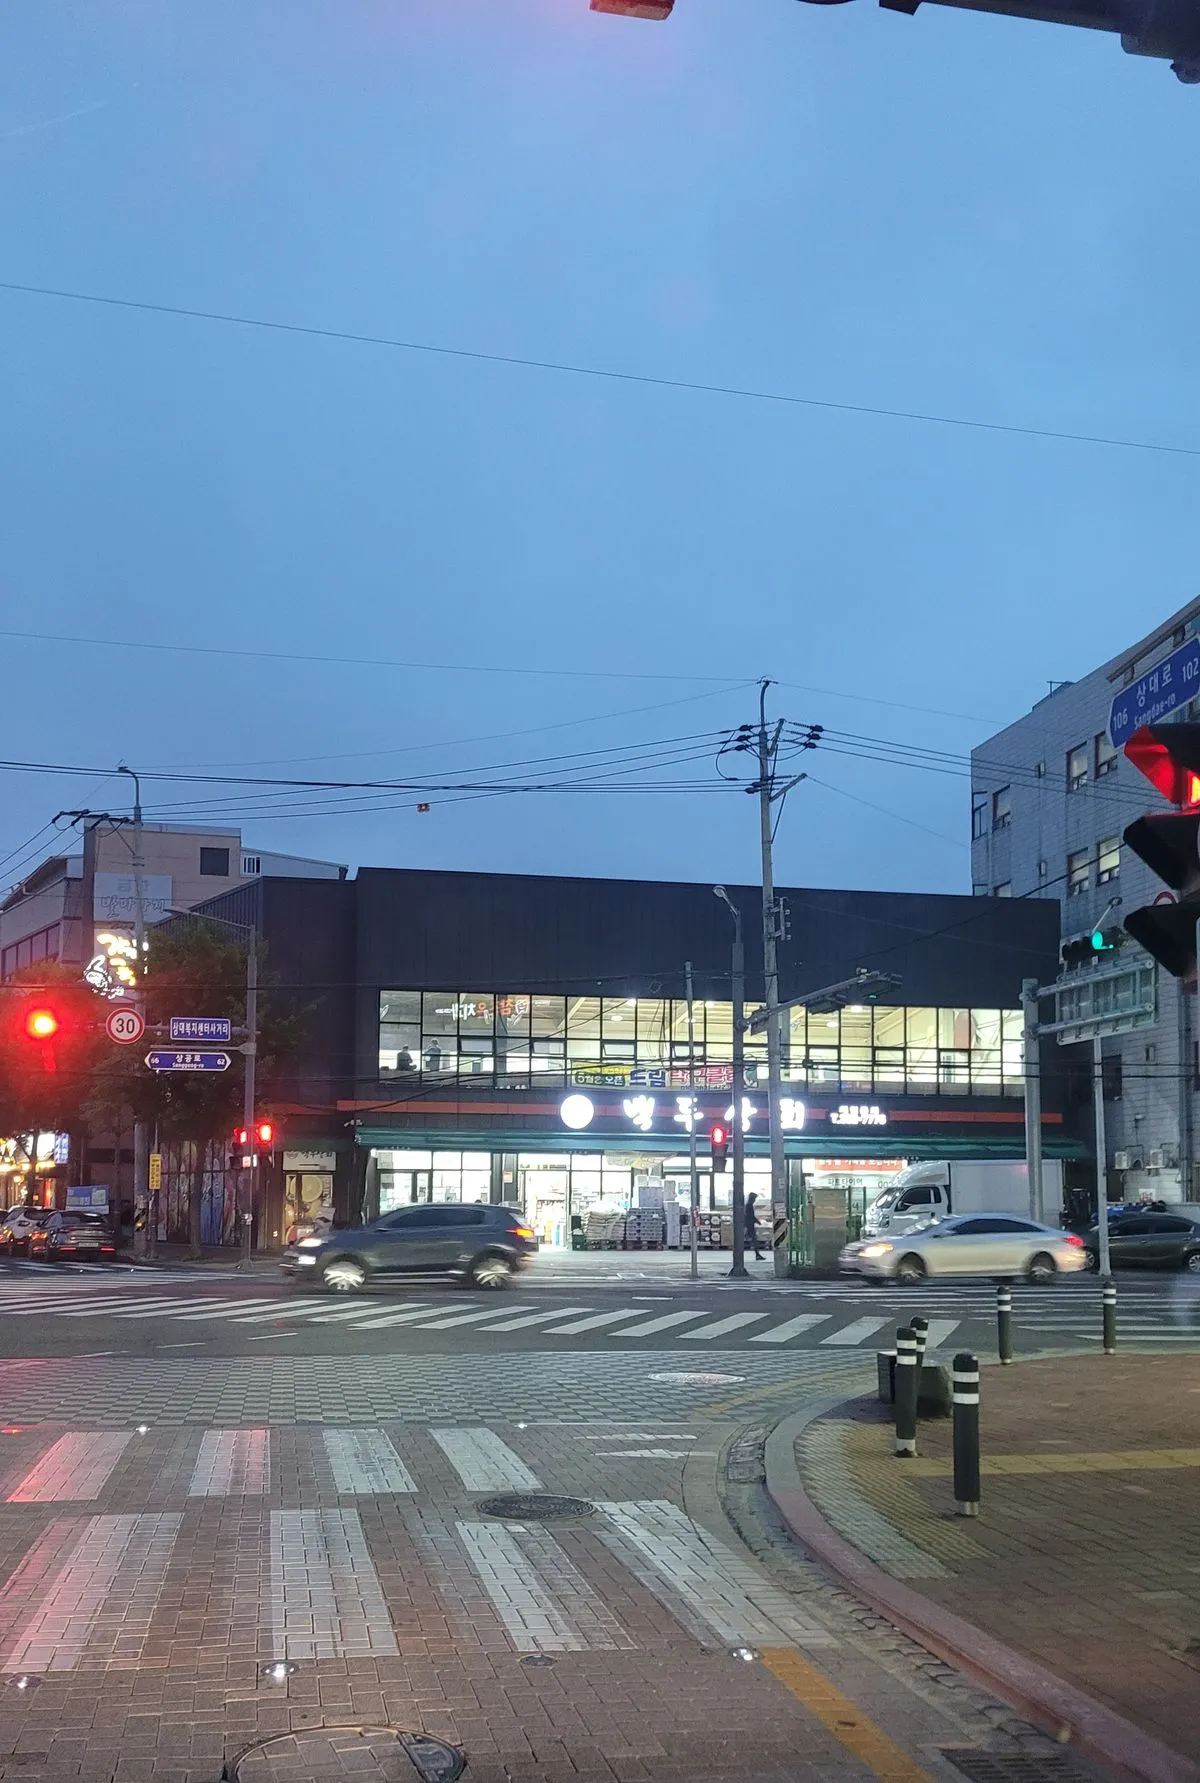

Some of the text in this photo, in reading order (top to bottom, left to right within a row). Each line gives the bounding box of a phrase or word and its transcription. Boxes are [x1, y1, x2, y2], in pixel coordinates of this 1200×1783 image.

[1113, 658, 1199, 731] 106 상대로 102
[115, 1018, 135, 1034] 30
[172, 1021, 229, 1036] 상대복지센터사거리
